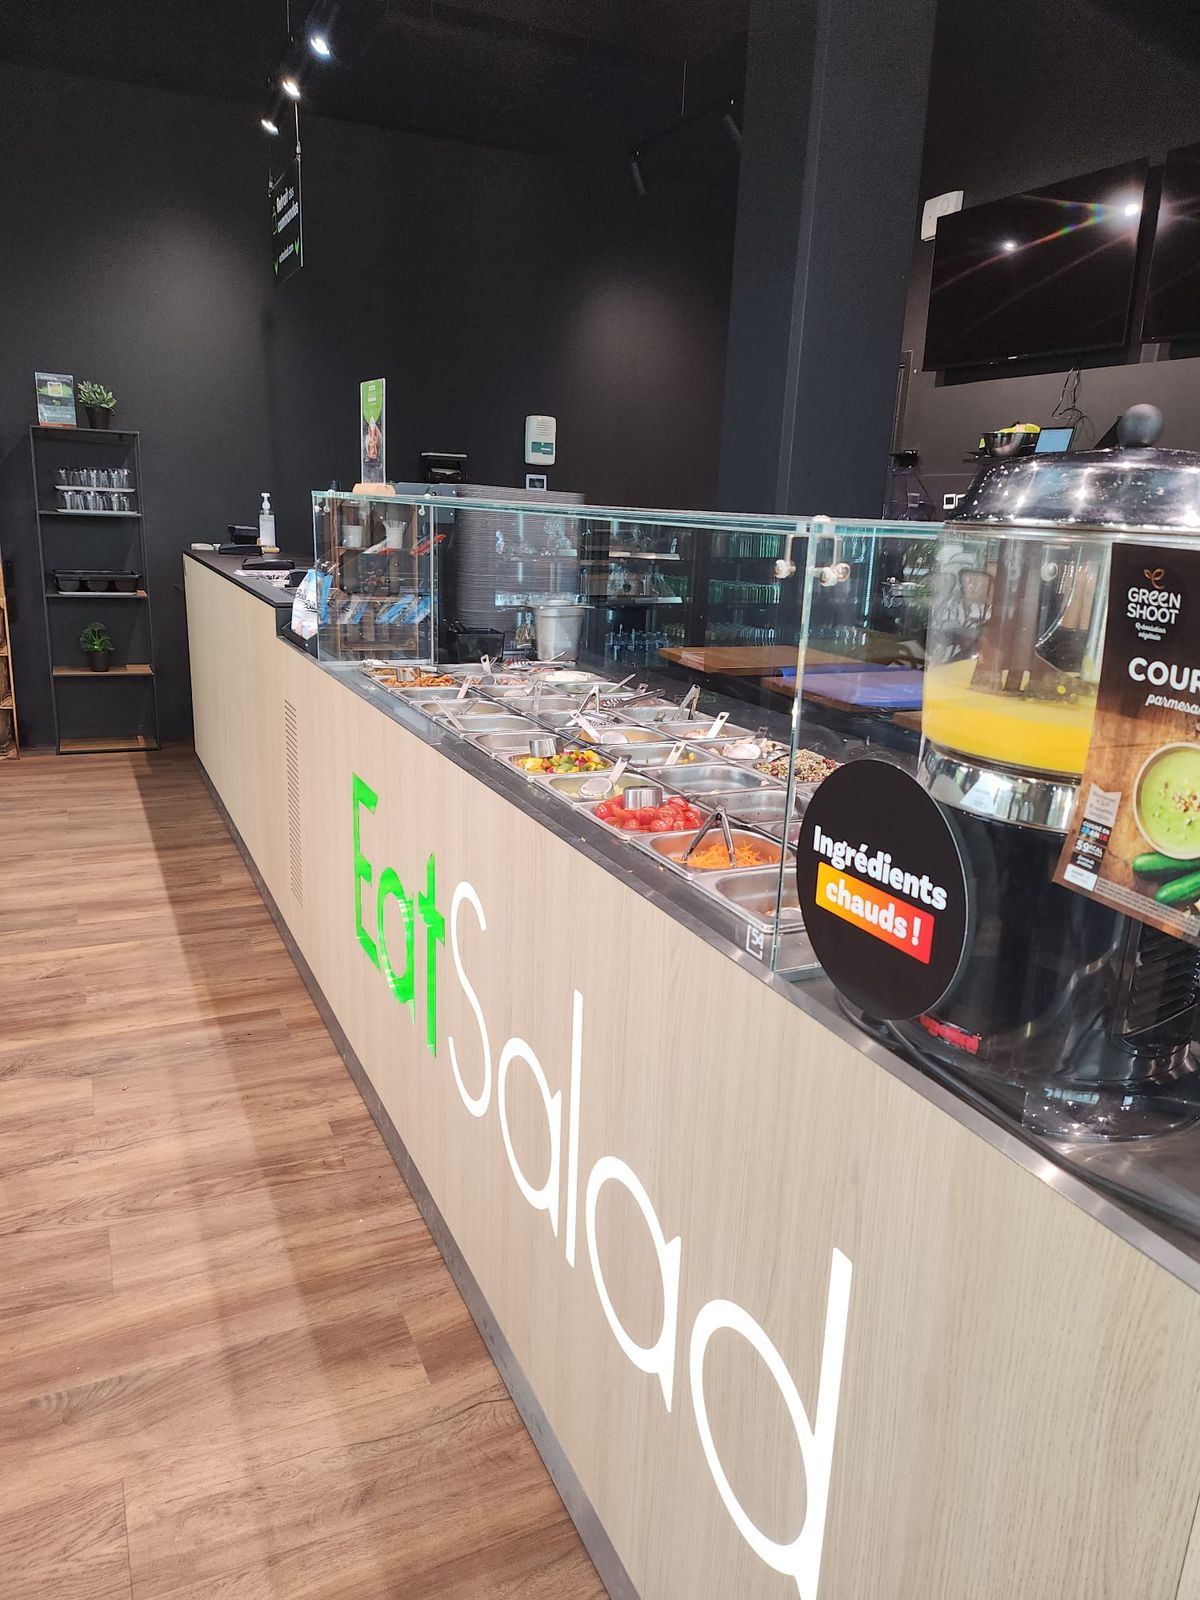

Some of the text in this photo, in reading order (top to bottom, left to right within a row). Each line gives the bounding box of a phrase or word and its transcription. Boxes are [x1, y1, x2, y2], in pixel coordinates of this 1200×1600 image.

[1126, 602, 1180, 625] SHOOT
[812, 824, 949, 911] Ingrédients
[825, 878, 908, 940] chauds
[351, 770, 853, 1600] Eat Salad
